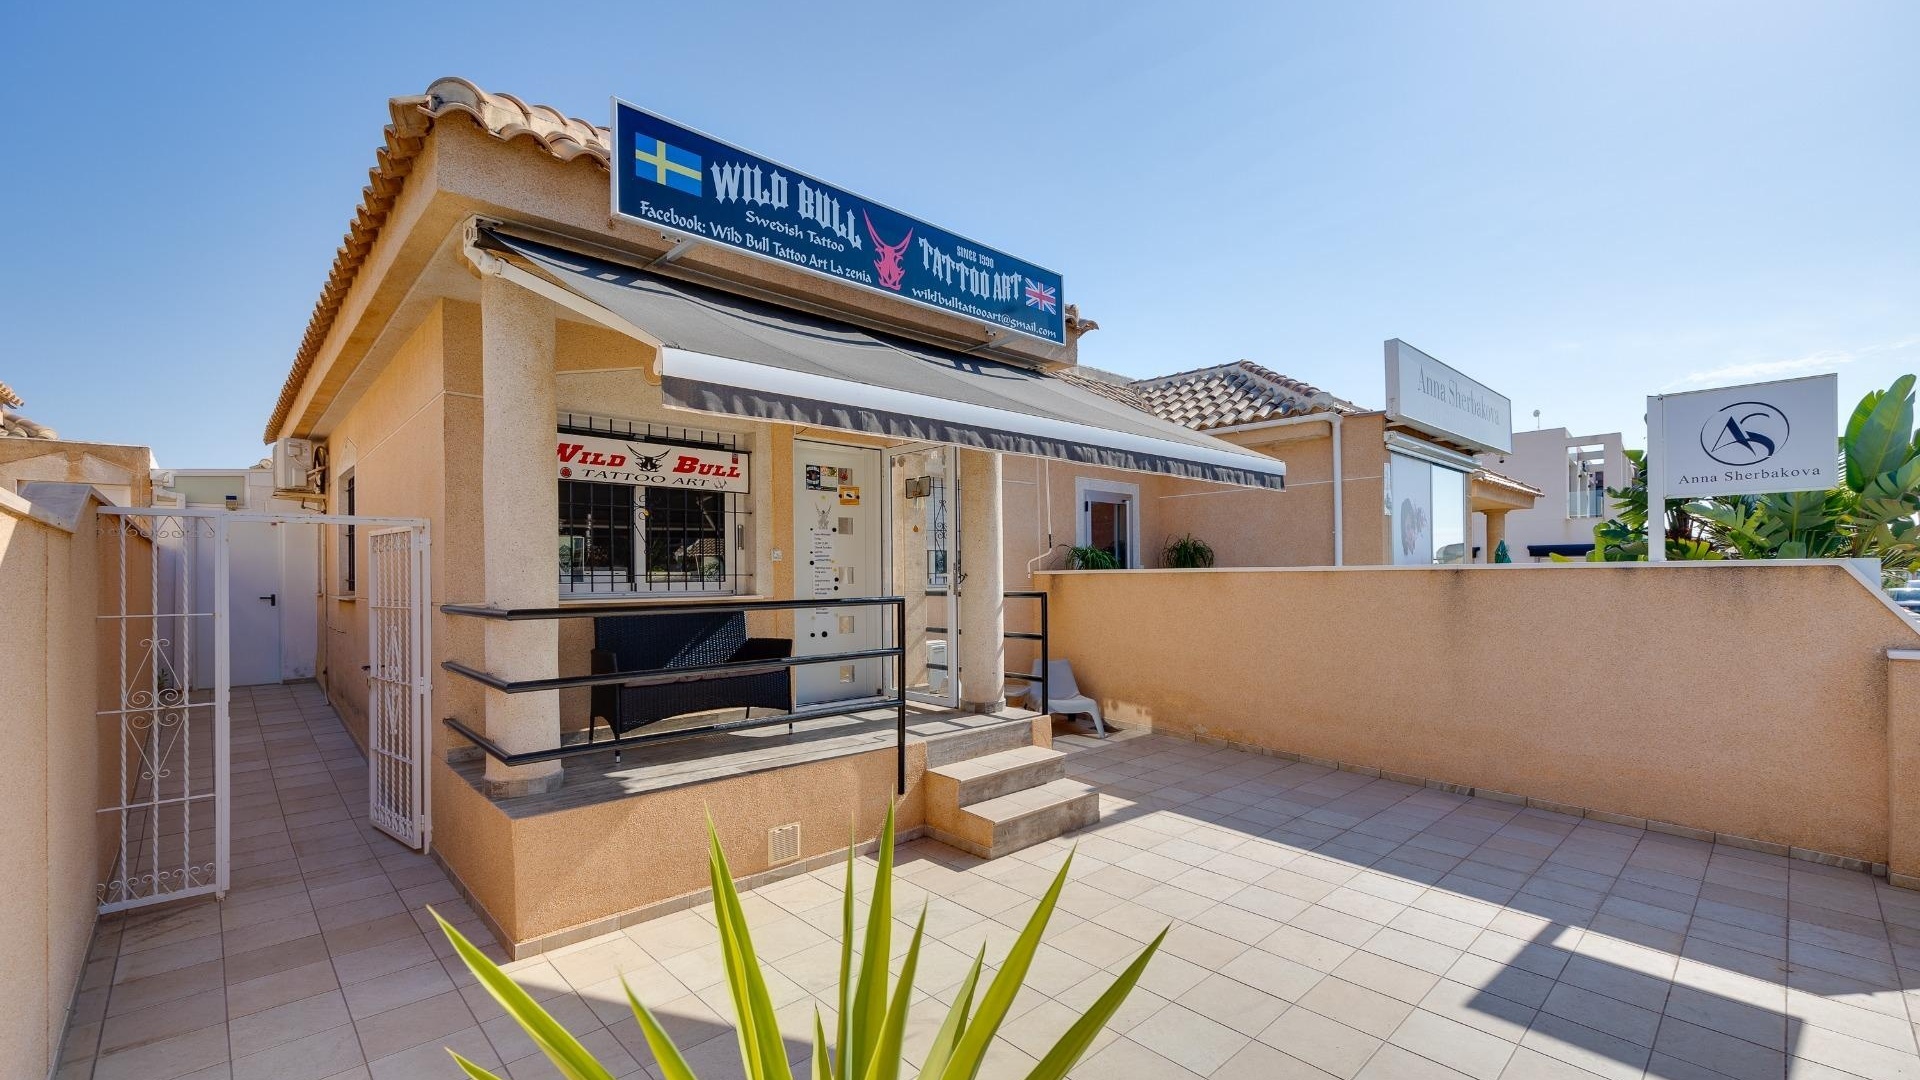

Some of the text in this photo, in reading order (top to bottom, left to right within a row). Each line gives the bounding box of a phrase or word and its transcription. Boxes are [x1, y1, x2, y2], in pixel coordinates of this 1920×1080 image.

[710, 160, 862, 251] WILD BULL
[745, 210, 845, 253] Swedish Tattoo
[639, 200, 872, 284] Facebook: Wild Bull Tattoo Art La zenia
[956, 245, 977, 263] SINCE
[918, 236, 1023, 303] TATTOO ART
[1417, 363, 1500, 426] Anna Sherbakova
[581, 468, 710, 487] TATTOO ART
[1677, 466, 1821, 485] Anna Sherbakova
